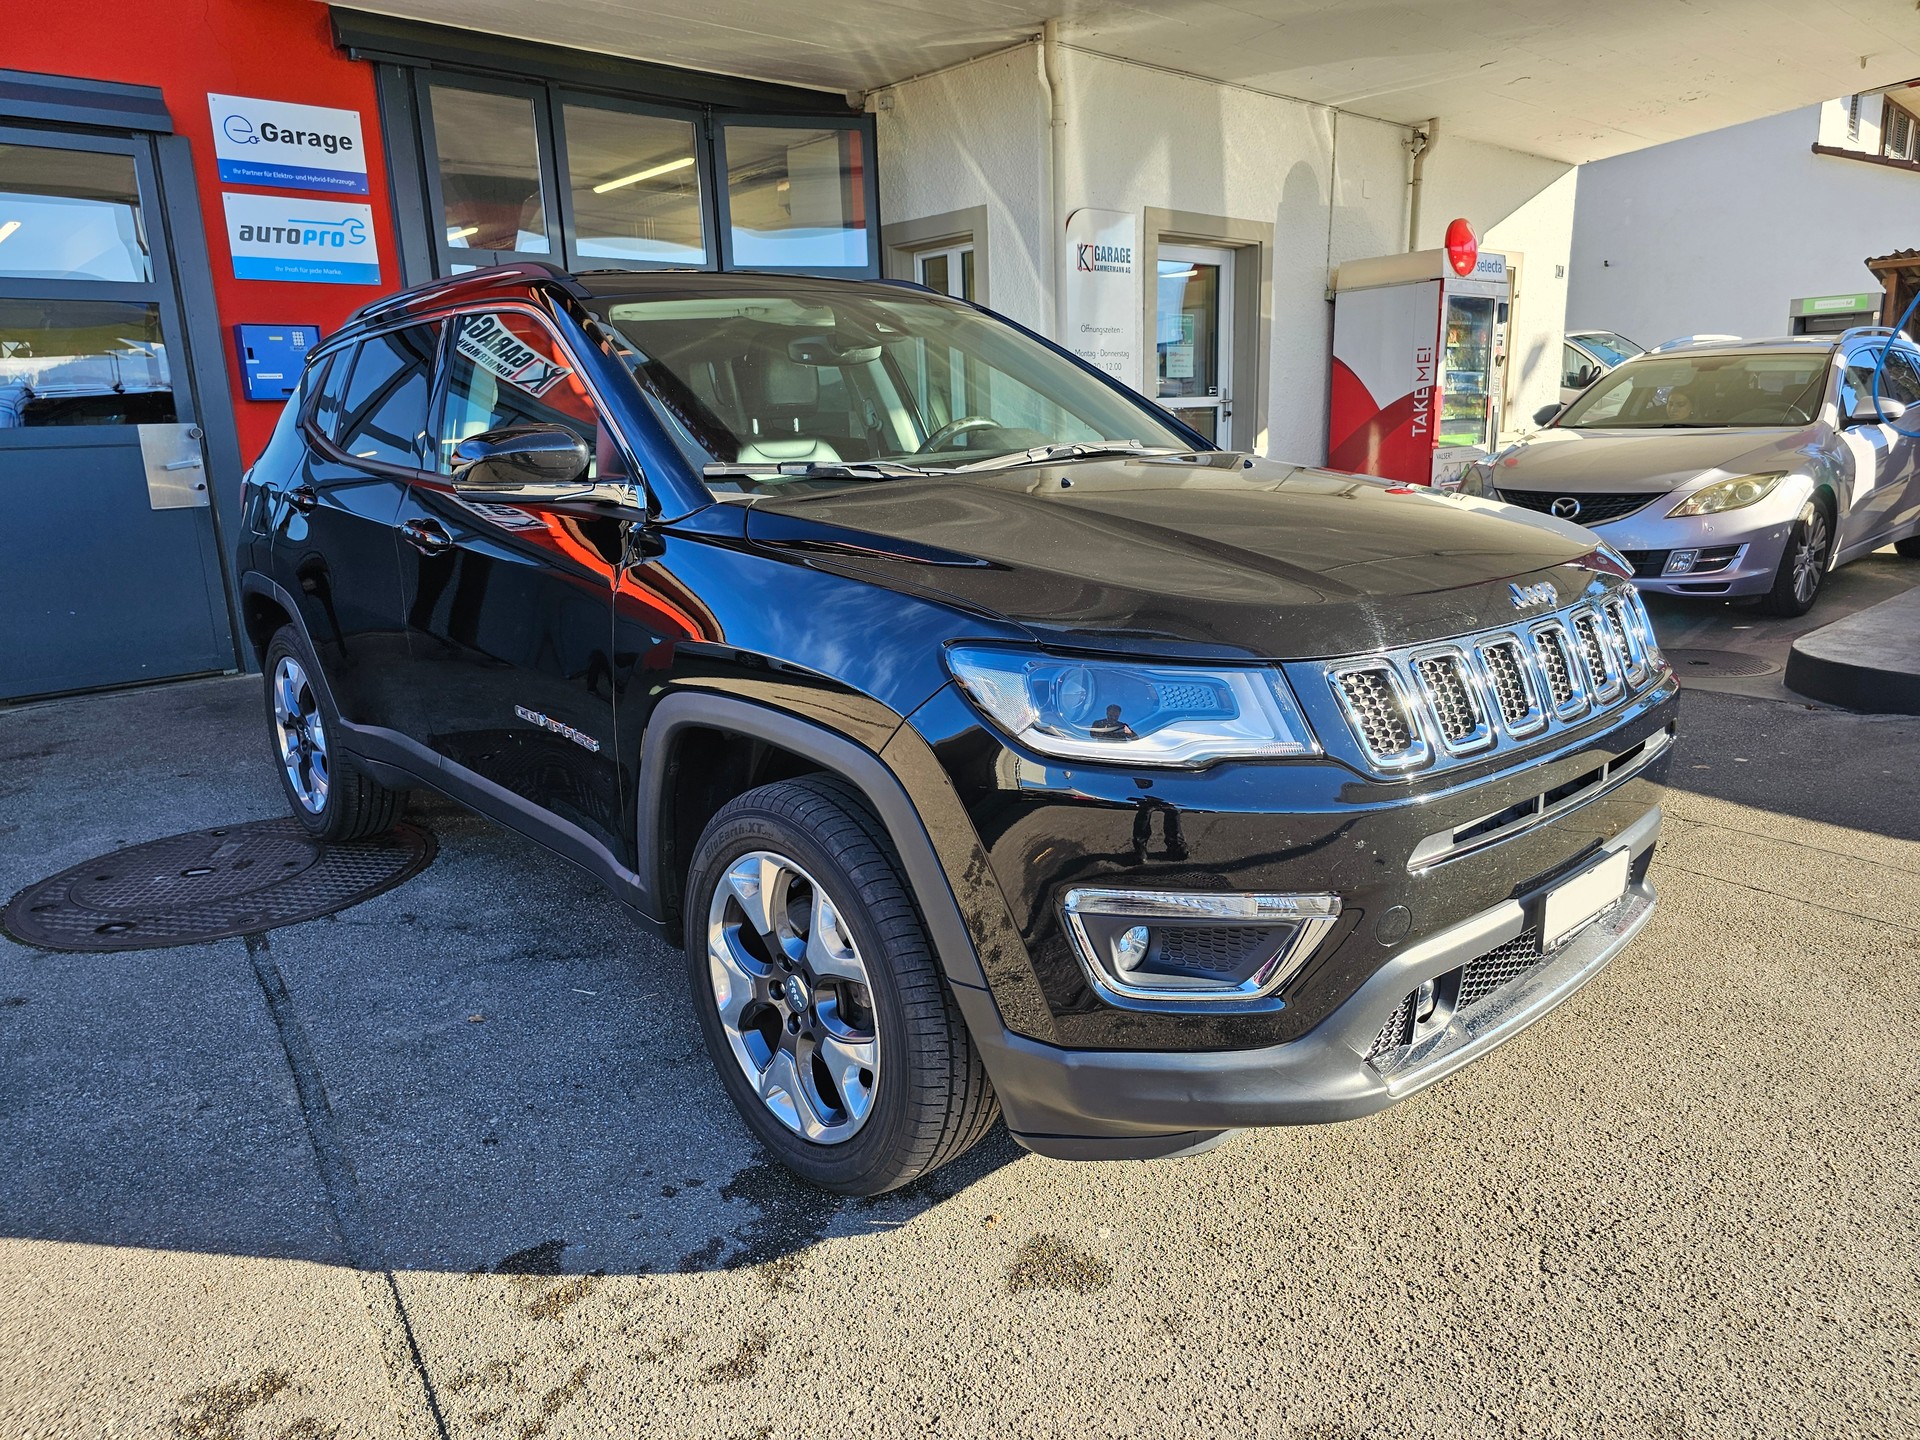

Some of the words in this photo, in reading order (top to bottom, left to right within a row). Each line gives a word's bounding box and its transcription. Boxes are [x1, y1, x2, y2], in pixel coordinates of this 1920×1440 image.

[242, 168, 263, 177] Partner
[264, 170, 272, 178] für
[273, 171, 294, 180] Elektro-
[295, 173, 307, 181] und
[307, 174, 357, 187] Hybrid-Fahrzeuge.
[1094, 245, 1131, 264] GARAGE
[1094, 264, 1124, 274] KAMMERMANN
[1125, 266, 1131, 274] AG
[1476, 259, 1503, 274] selecta
[1074, 348, 1096, 360] Montag
[1100, 348, 1130, 360] Donnerstag
[1105, 362, 1122, 371] 12.00
[1416, 346, 1432, 382] ME!
[1411, 387, 1429, 438] TAKE
[1508, 581, 1558, 610] Jeep
